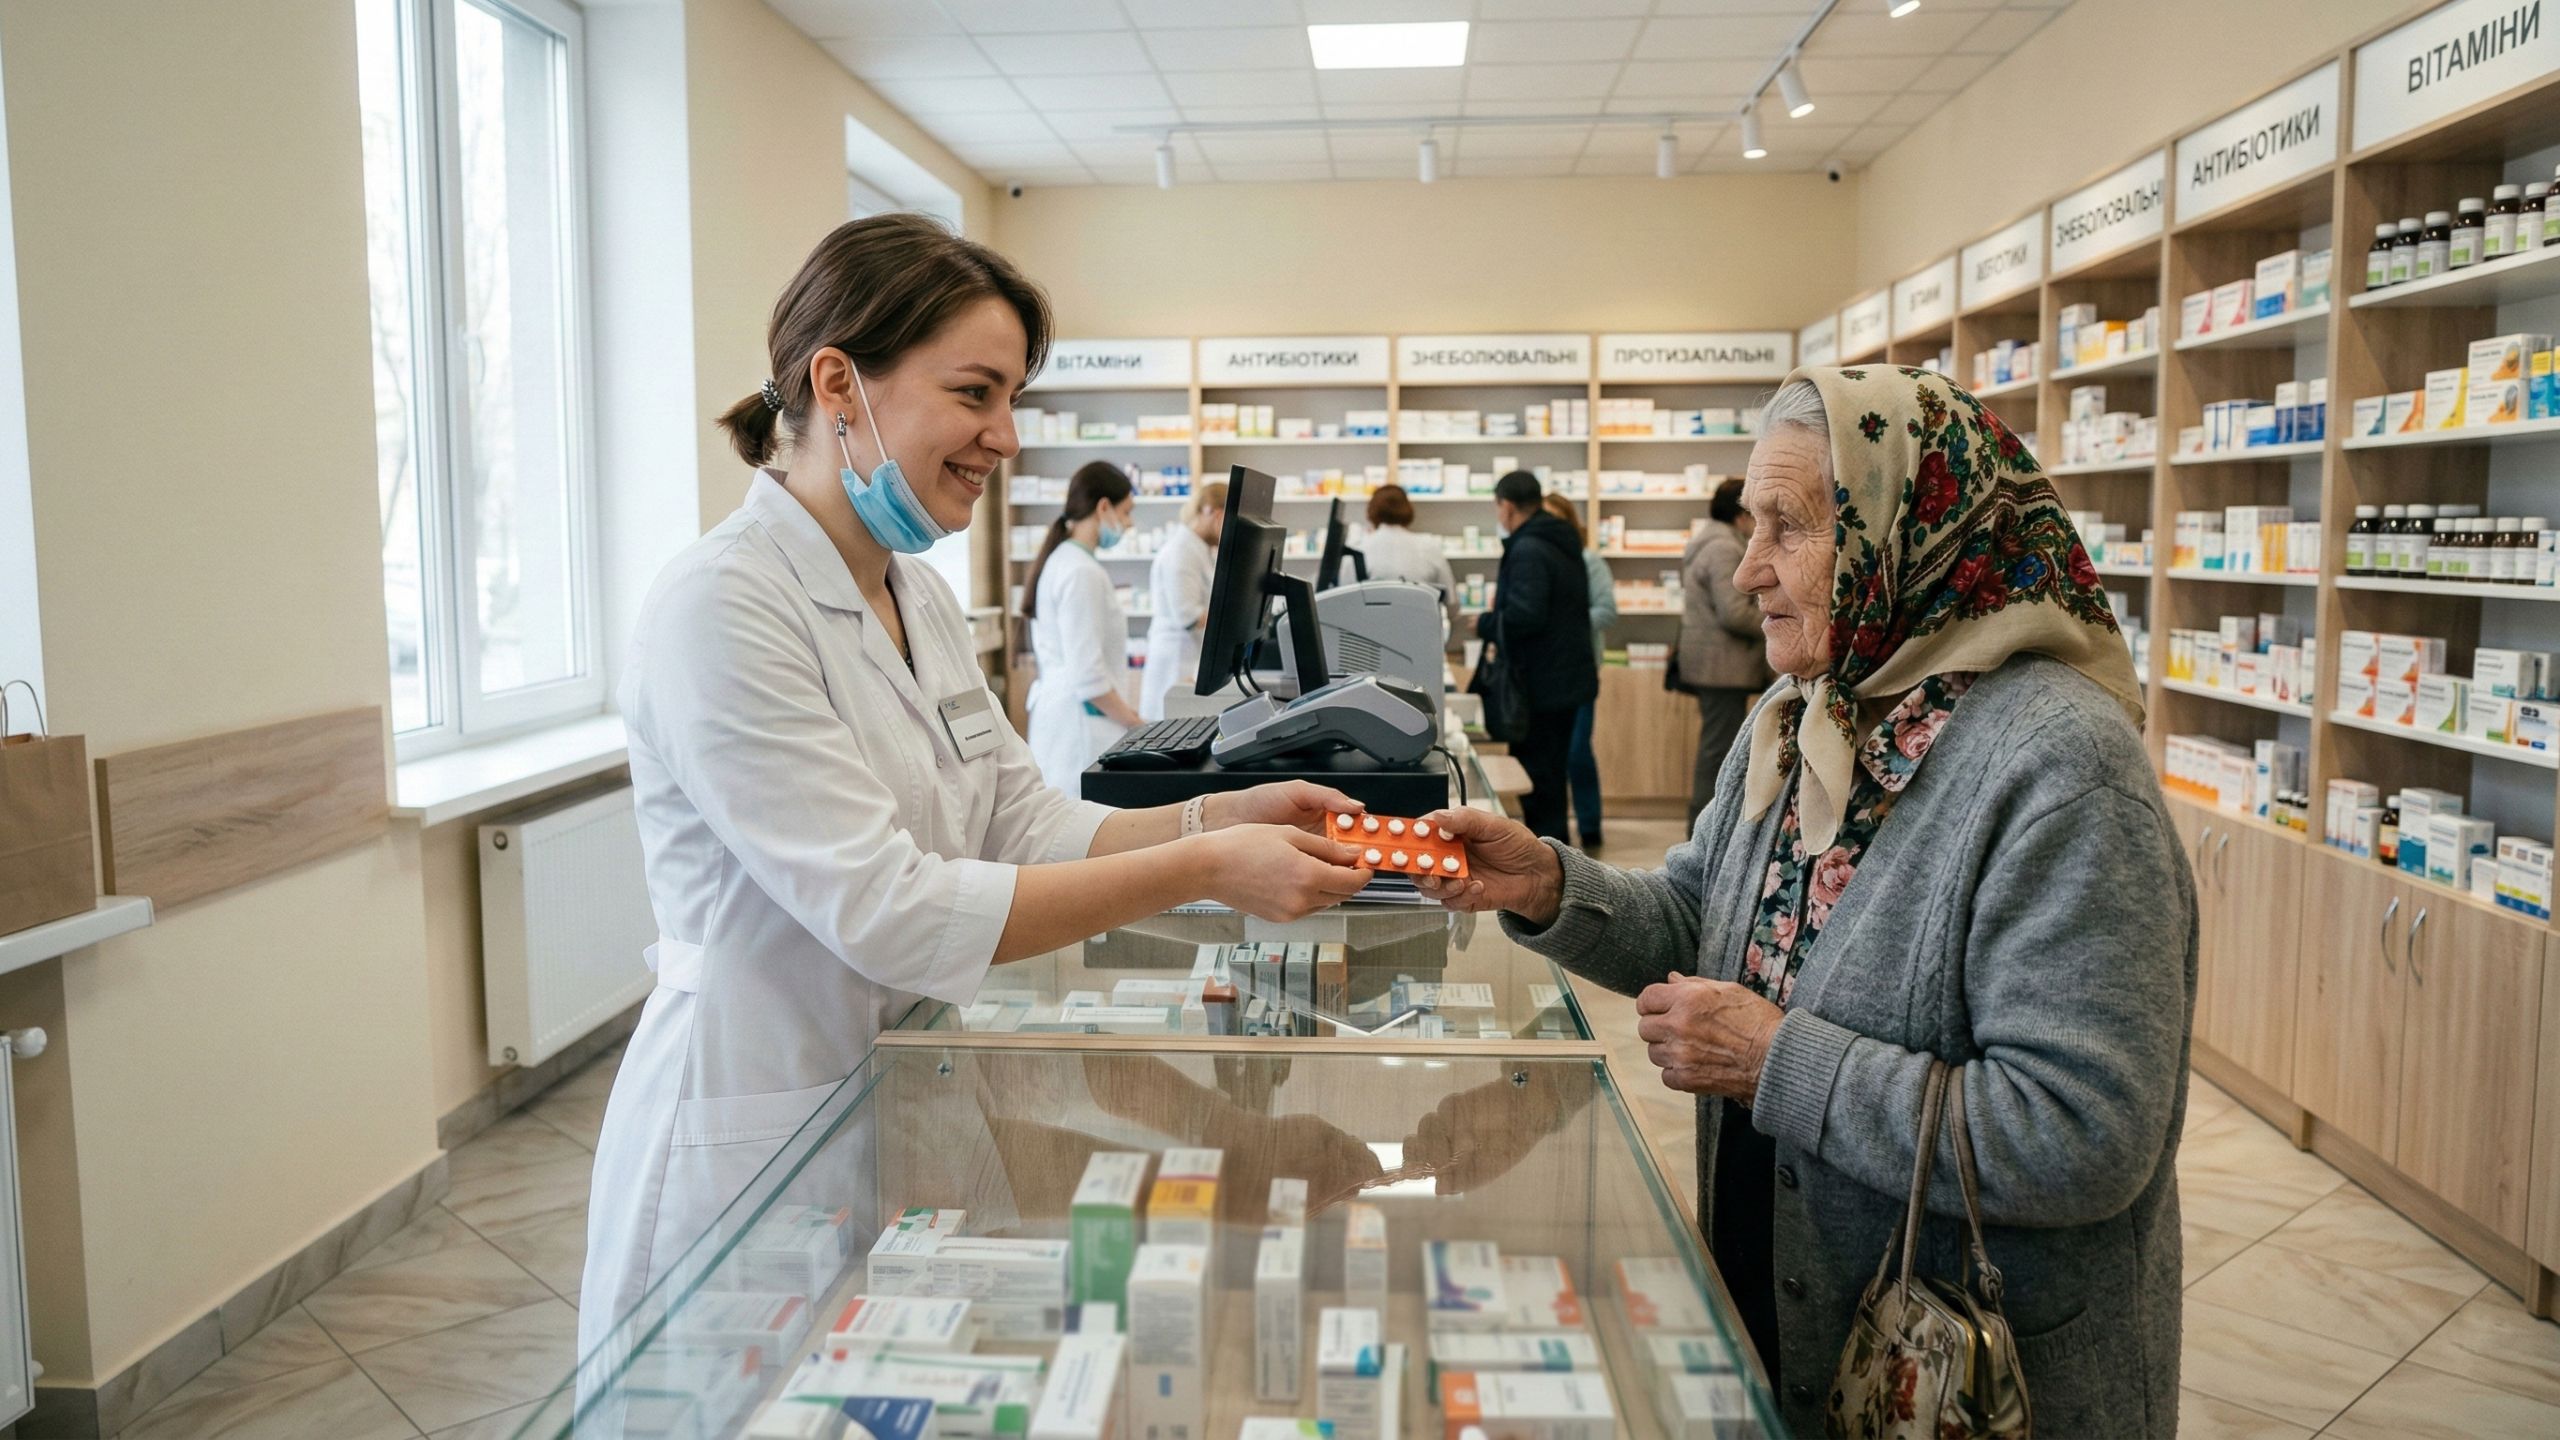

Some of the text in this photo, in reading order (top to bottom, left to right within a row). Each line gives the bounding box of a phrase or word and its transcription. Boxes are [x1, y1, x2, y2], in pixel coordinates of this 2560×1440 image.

[2406, 0, 2541, 95] ВІТАМІНИ
[2190, 103, 2322, 190] АНТИБІОТИКИ
[1056, 354, 1142, 372] ВІТАМІНИ
[1228, 350, 1359, 368] АНТИБІОТИКИ
[1412, 348, 1578, 366] ЗНЕБОЛЮВАЛЬНІ
[1614, 347, 1775, 365] ПРОТИЗАПАЛЬНІ
